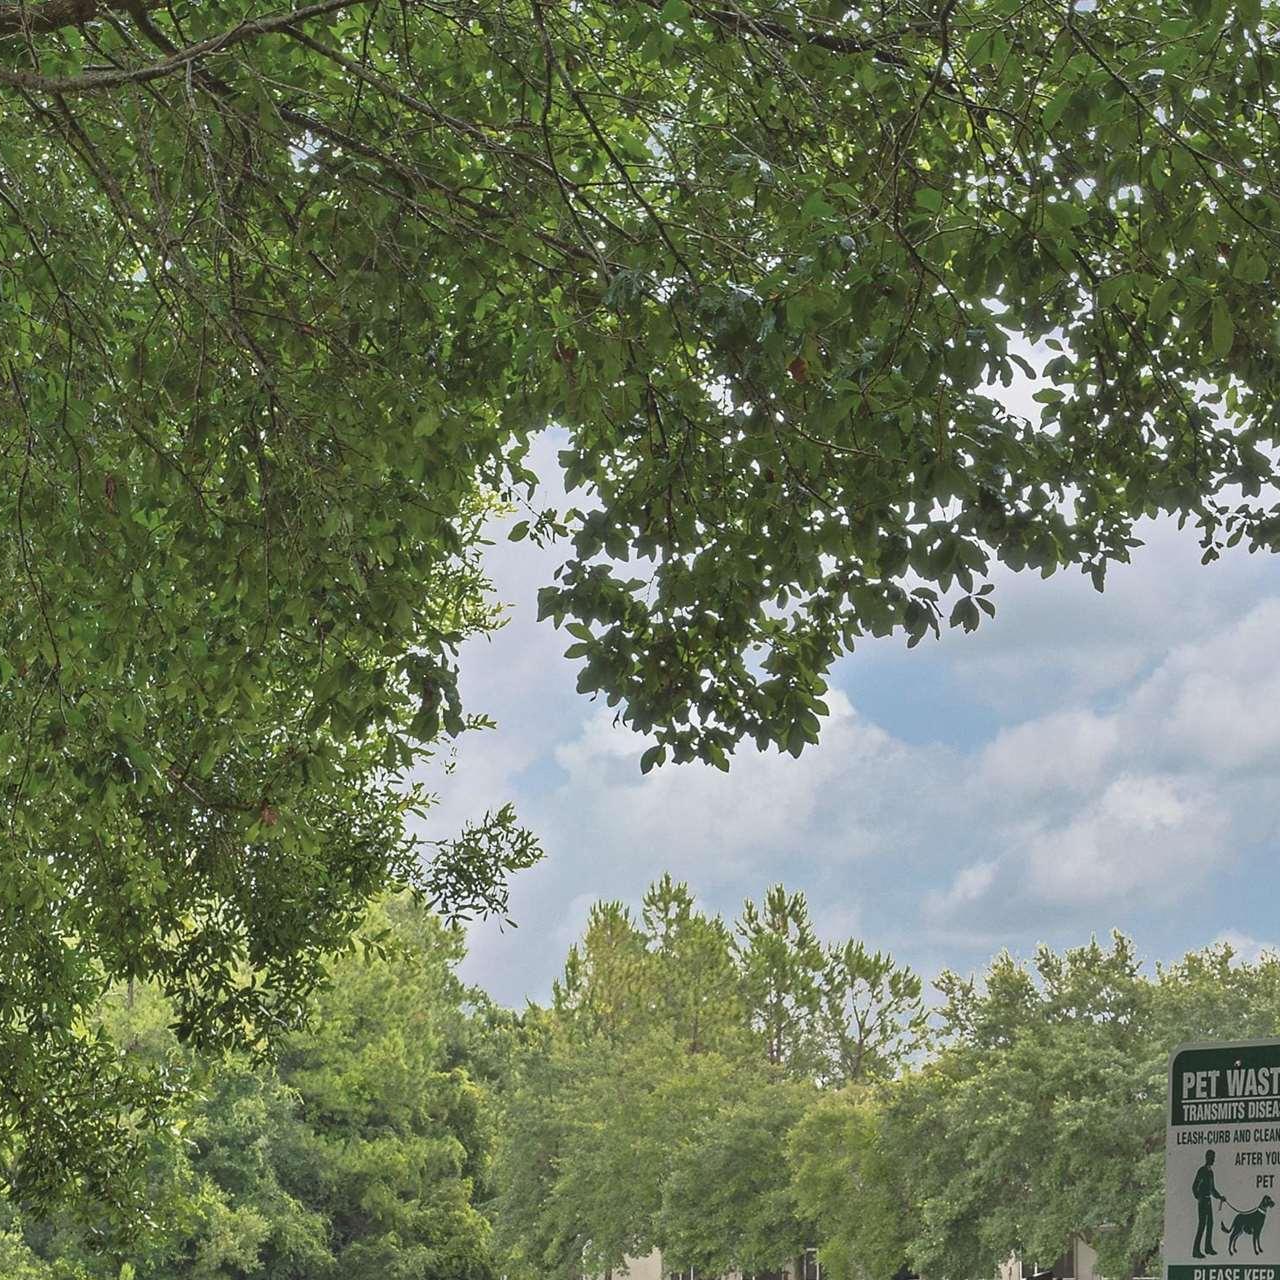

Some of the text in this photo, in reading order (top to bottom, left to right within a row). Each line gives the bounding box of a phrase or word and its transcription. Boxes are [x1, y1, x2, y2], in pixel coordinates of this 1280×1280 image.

[1182, 1070, 1220, 1099] PET
[1182, 1102, 1245, 1122] TRANSMITS
[1176, 1129, 1231, 1145] LEASH-CURB
[1233, 1129, 1251, 1143] AND
[1234, 1152, 1263, 1166] AFTER
[1256, 1175, 1274, 1188] PET
